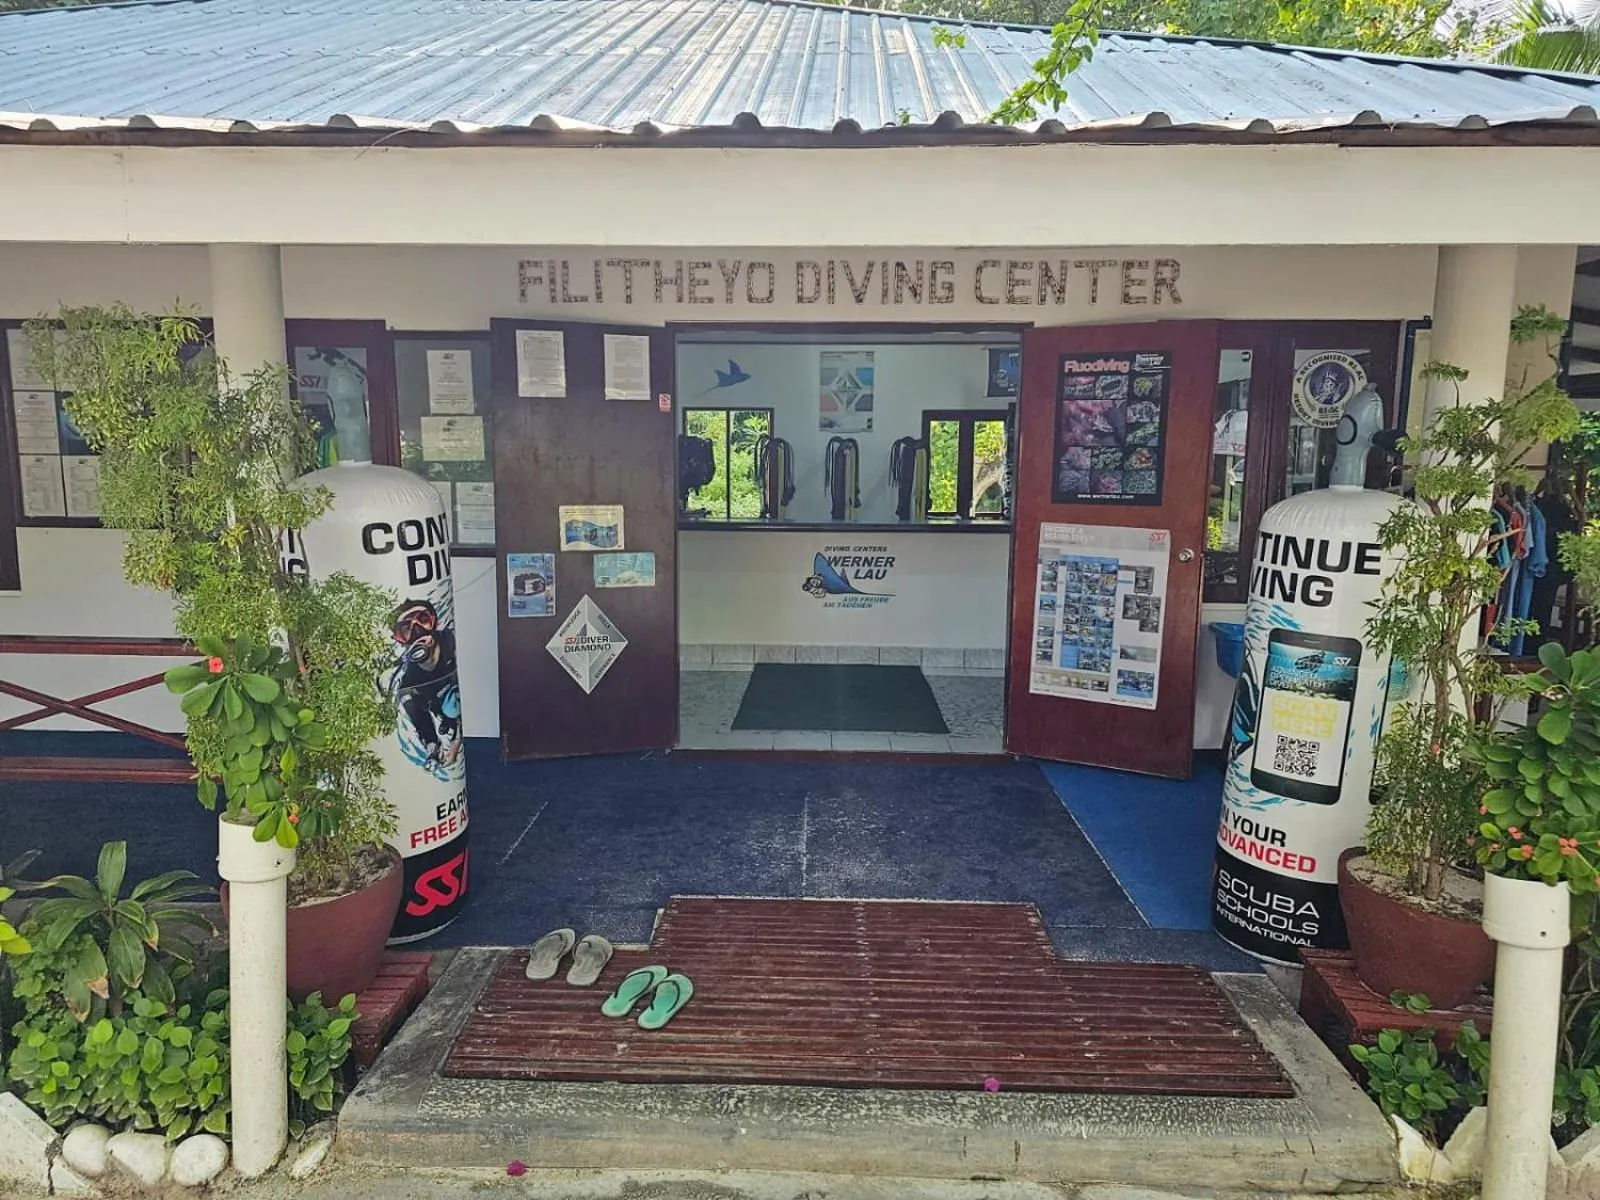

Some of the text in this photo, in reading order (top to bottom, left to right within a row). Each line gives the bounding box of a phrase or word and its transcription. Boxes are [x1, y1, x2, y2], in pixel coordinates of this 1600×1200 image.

[518, 257, 1183, 305] FILITHEYO DIVING CENTER
[1064, 358, 1131, 373] Fluodiving
[824, 545, 888, 553] DIVING CENTERS
[1258, 530, 1382, 576] TINUE
[828, 556, 896, 568] WERNER
[853, 568, 888, 580] LAU
[837, 601, 873, 609] TAUCHEN
[564, 643, 611, 653] DIAMOND
[581, 635, 610, 644] DIVER
[1332, 657, 1352, 667] SSI
[1272, 695, 1338, 720] SCAN
[1272, 715, 1334, 738] HERE
[410, 816, 458, 849] FREE
[1231, 811, 1287, 848] YOUR
[1219, 868, 1320, 919] SCUBA
[1217, 887, 1319, 936] SCHOOLS
[1216, 903, 1316, 948] INTERNATIONAL
